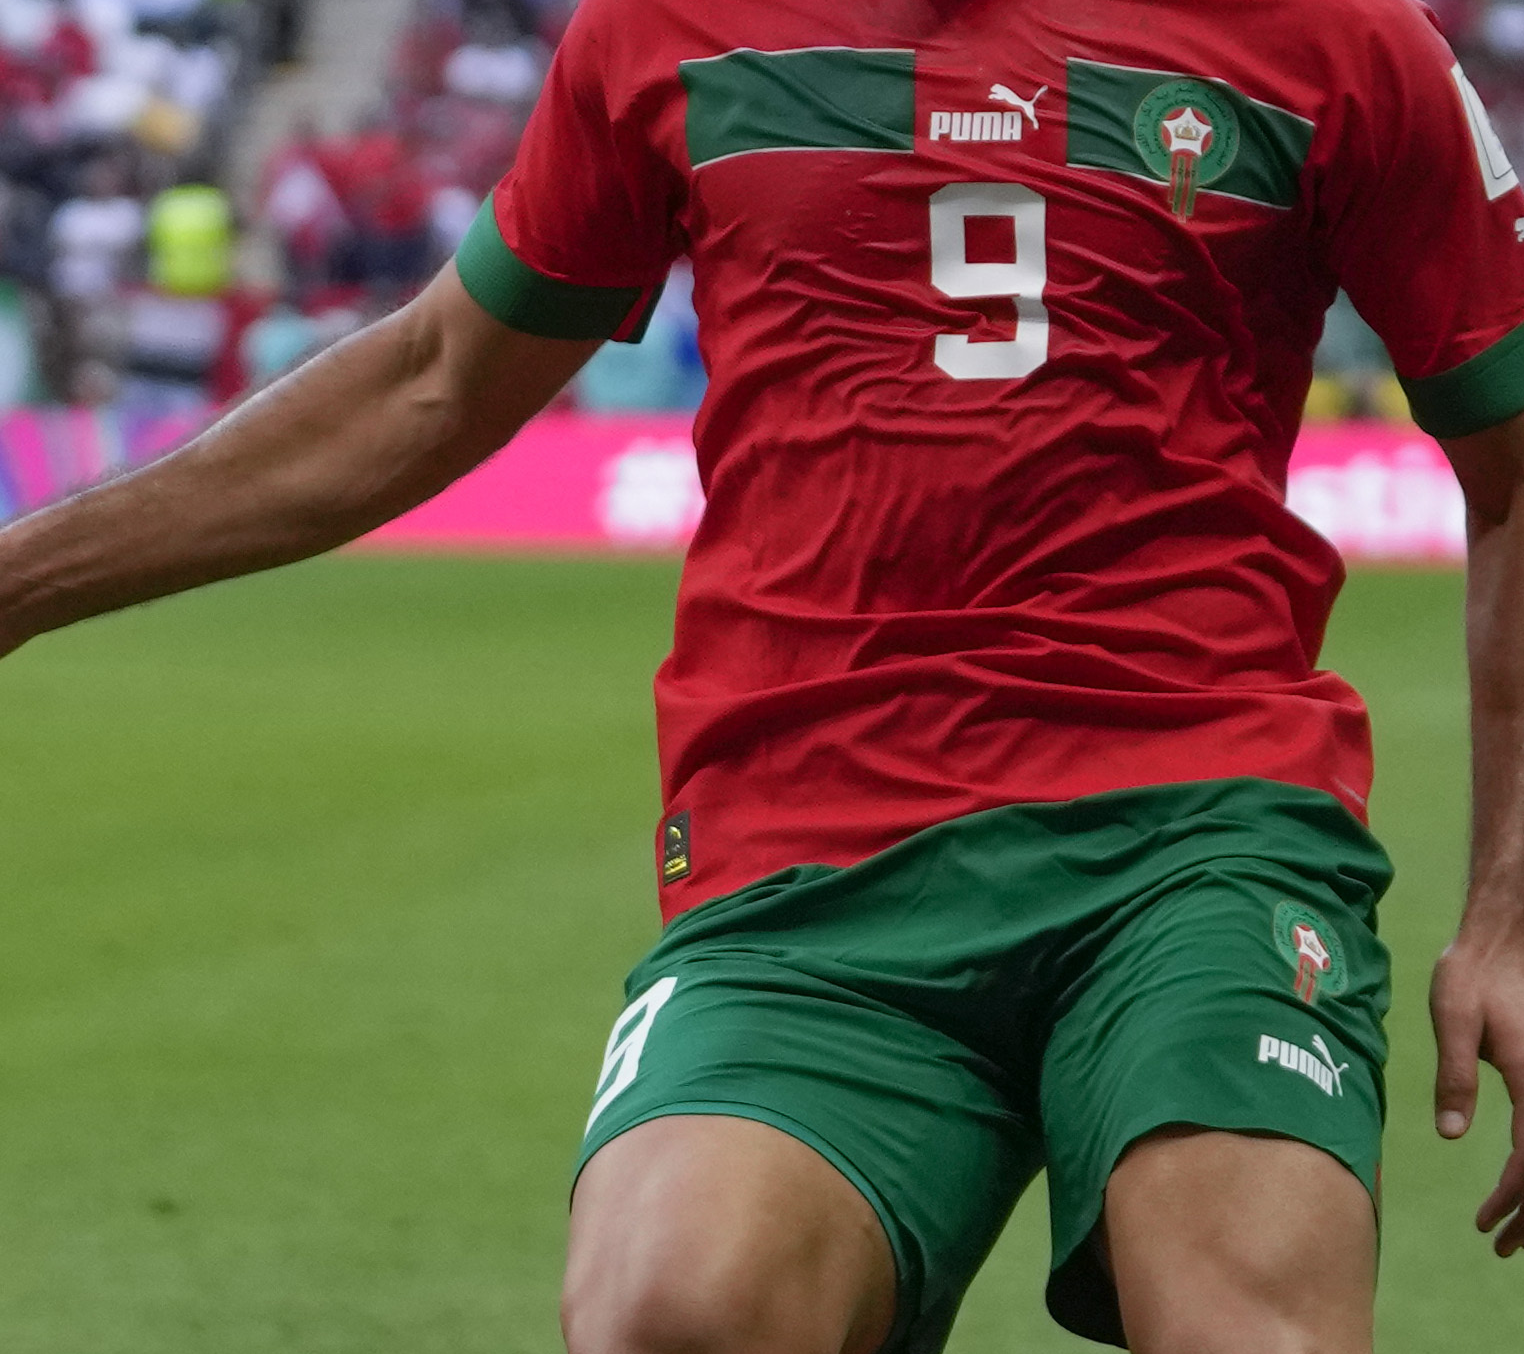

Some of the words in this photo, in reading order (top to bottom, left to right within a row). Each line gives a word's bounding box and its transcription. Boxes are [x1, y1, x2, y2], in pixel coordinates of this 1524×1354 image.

[929, 111, 1023, 141] PUMA
[928, 182, 1049, 380] 9
[583, 976, 679, 1139] 9
[1257, 1033, 1334, 1097] PUMA
